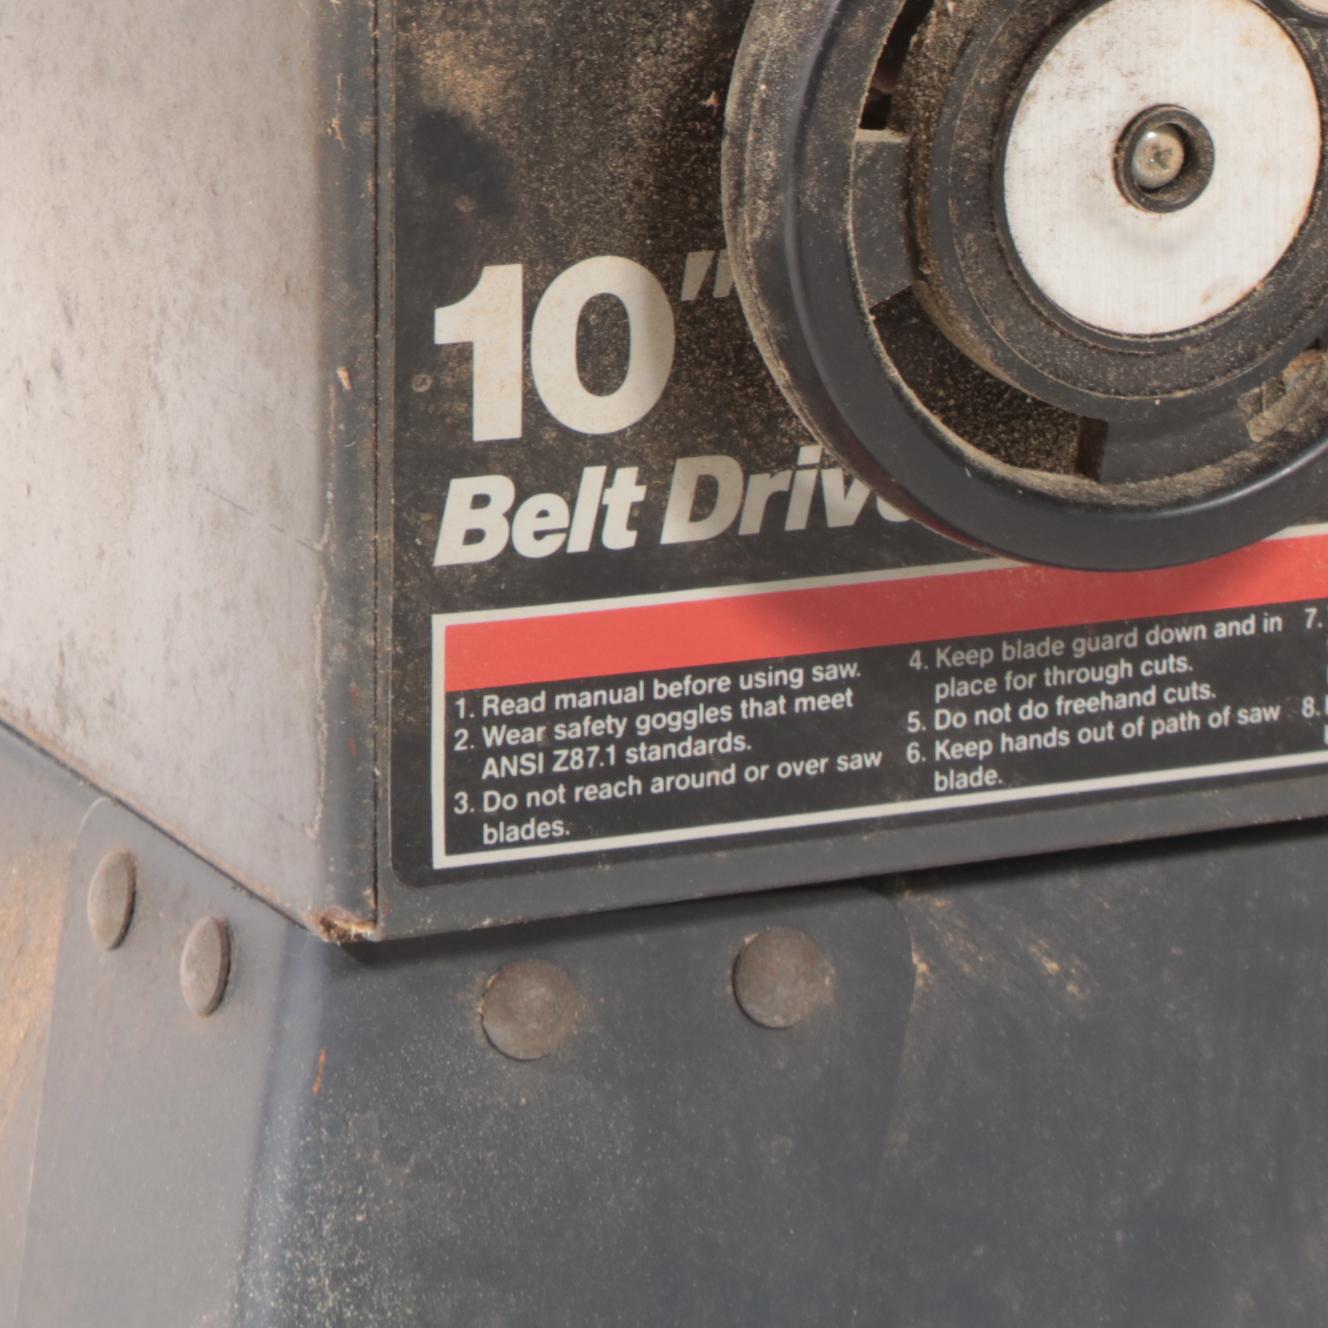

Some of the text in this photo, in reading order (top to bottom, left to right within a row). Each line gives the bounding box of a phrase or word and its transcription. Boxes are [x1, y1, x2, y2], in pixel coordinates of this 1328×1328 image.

[433, 465, 646, 566] Belt
[908, 612, 1282, 672] 4. Keep blade guard down and in
[1304, 607, 1322, 629] 7.
[455, 661, 861, 719] 1. Read manual before using saw.
[934, 655, 1193, 702] place for through cuts.
[454, 690, 854, 751] 2. Wear safety goggles that meet
[906, 680, 1216, 733] 5. Do not do freehand cuts.
[1301, 697, 1319, 718] 8.
[482, 731, 752, 780] ANSI Z87.1 standards.
[906, 703, 1280, 765] 6. Keep hands out of path of saw
[454, 749, 883, 814] 3. Do not reach around or over saw
[934, 767, 1003, 792] blade.
[482, 819, 571, 846] blades.
